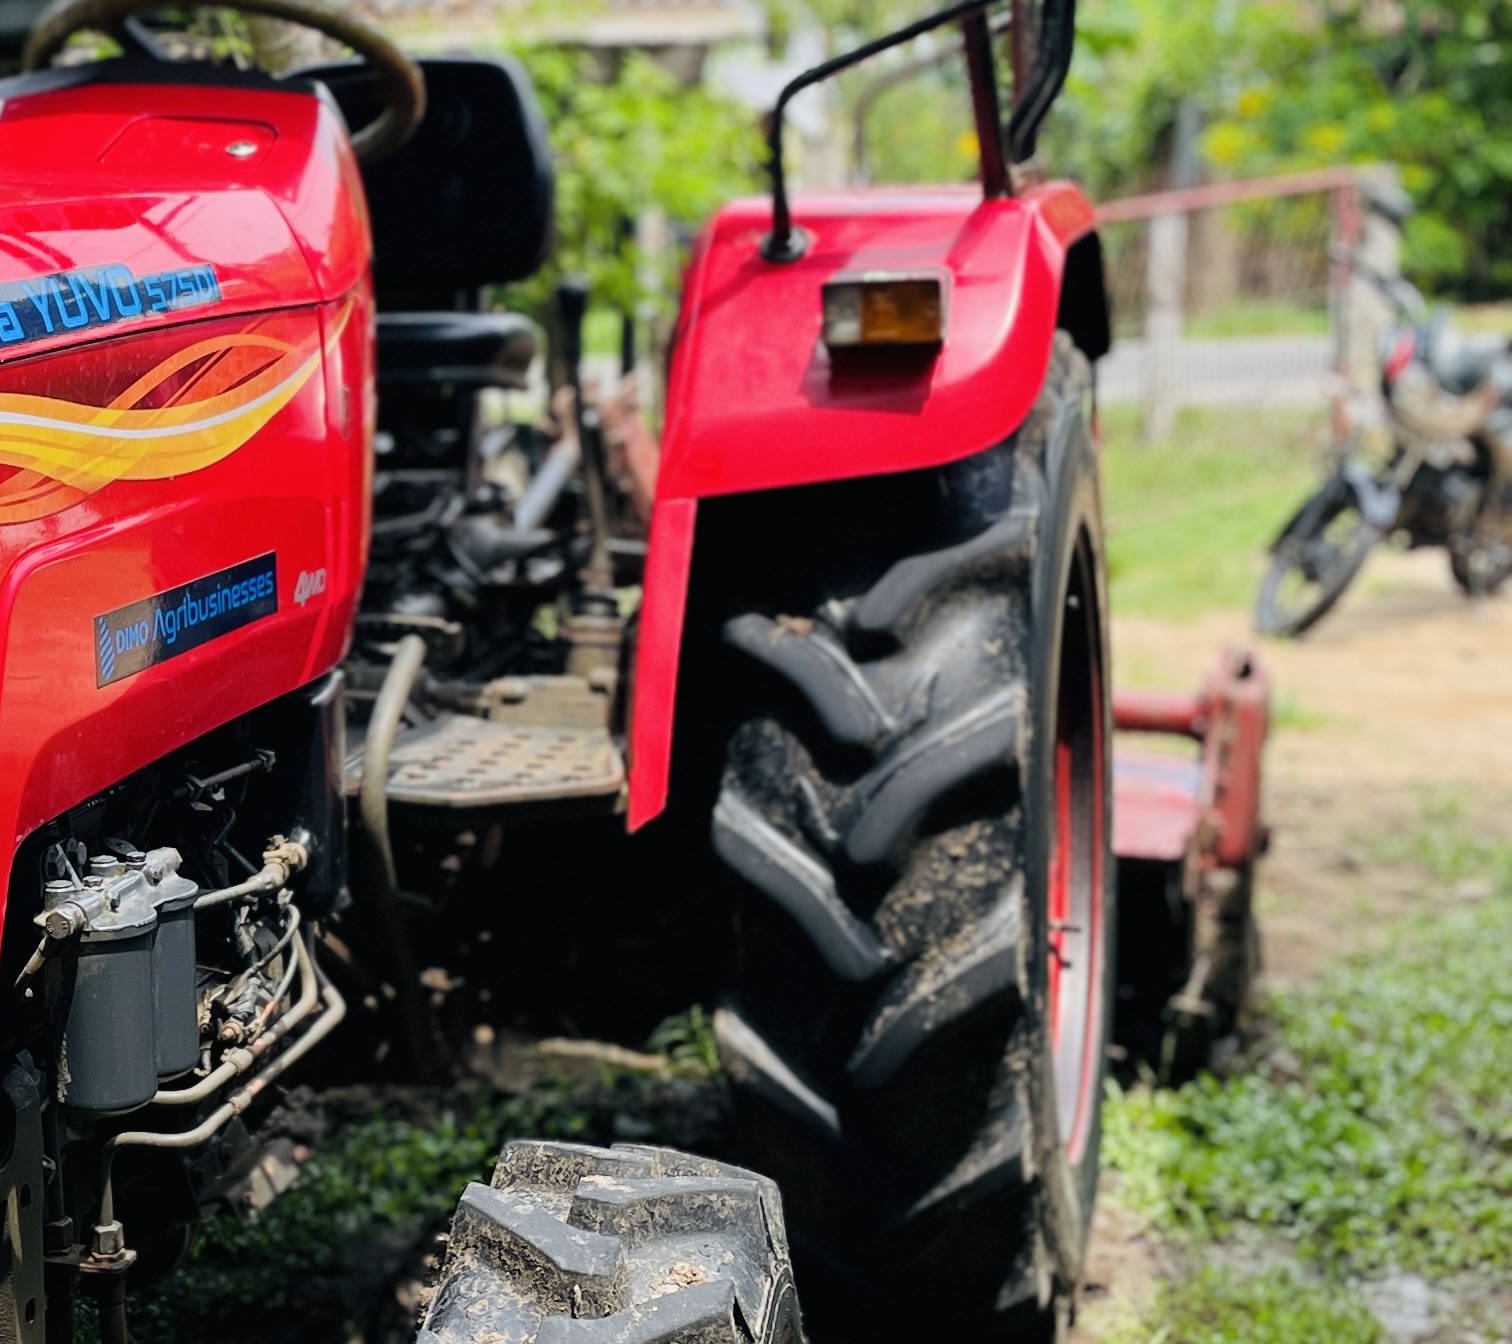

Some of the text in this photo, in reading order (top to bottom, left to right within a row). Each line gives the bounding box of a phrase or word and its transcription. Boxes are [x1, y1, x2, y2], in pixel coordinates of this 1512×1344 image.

[21, 264, 143, 334] YUVO
[115, 570, 274, 655] DIMO Agribusinesses
[294, 568, 327, 607] 4WD
